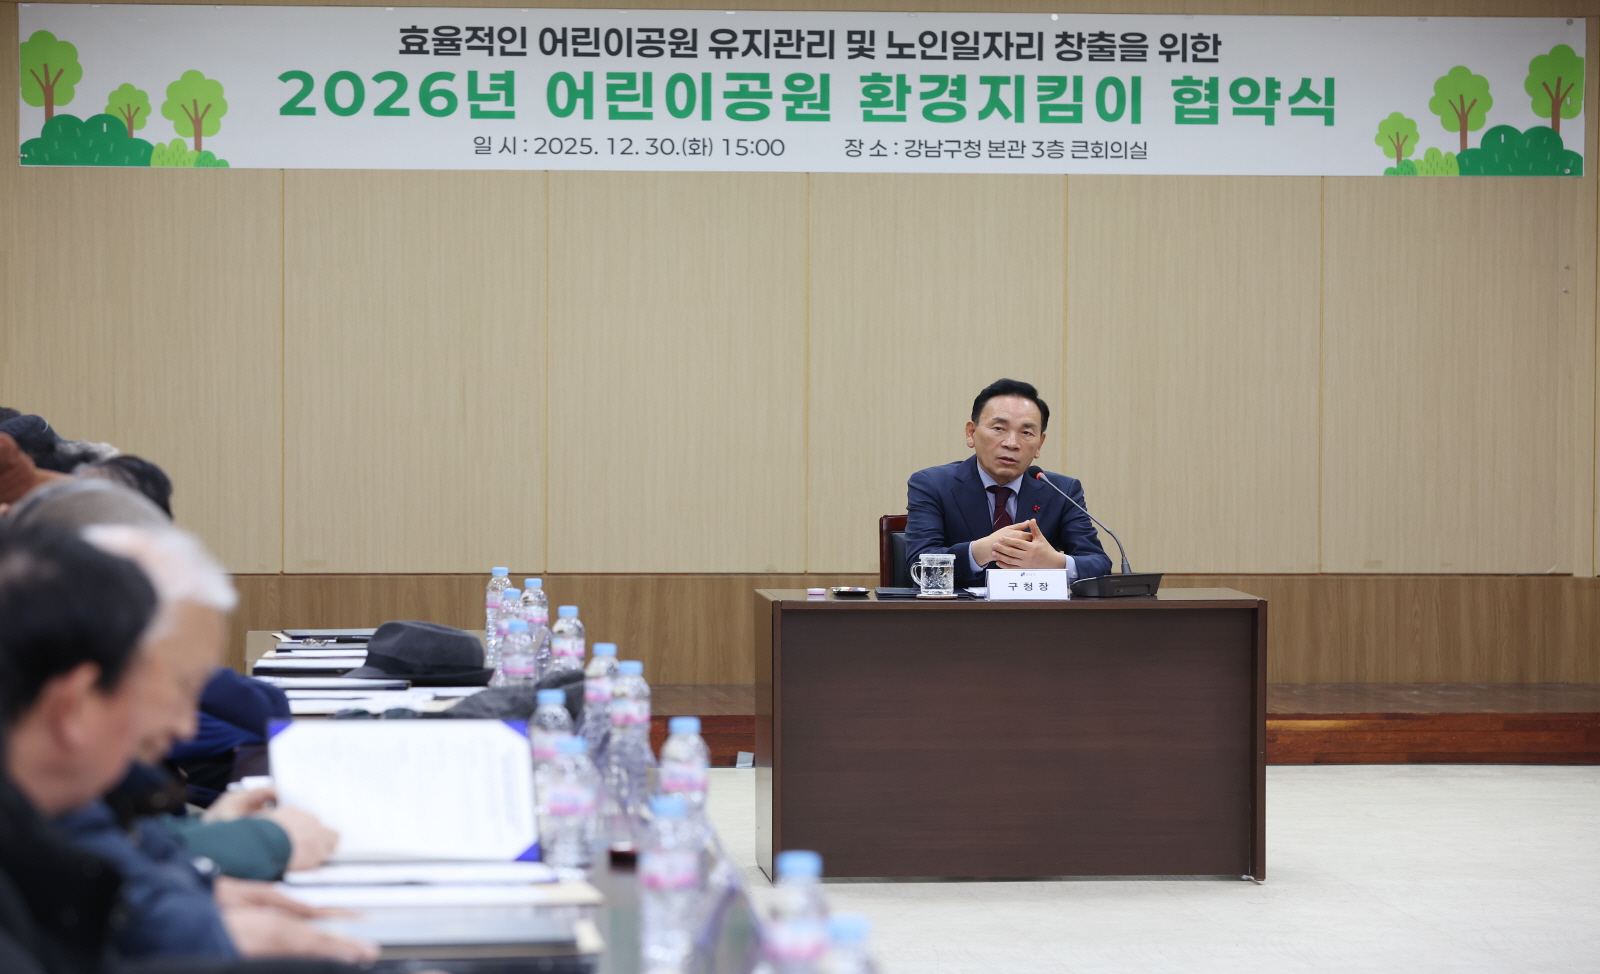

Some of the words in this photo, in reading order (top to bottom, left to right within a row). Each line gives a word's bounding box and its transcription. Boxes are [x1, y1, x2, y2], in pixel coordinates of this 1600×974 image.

[398, 25, 528, 57] 효율적인
[538, 27, 698, 59] 어린이공원
[708, 28, 835, 60] 유지관리
[846, 30, 876, 60] 및
[885, 30, 1044, 62] 노인일자리
[1054, 31, 1149, 63] 창출을
[1158, 32, 1223, 64] 위한
[278, 70, 516, 120] 2026년
[547, 71, 831, 122] 어린이공원
[860, 73, 1142, 124] 환경지킴이
[1172, 76, 1336, 126] 협약식
[534, 137, 599, 155] 2025.
[607, 137, 639, 155] 12.
[645, 137, 713, 157] 30.(화)
[722, 138, 785, 157] 15:00
[904, 139, 982, 159] 강남구청
[987, 140, 1027, 159] 본관
[1031, 140, 1065, 159] 3층
[1070, 140, 1148, 160] 큰회의실
